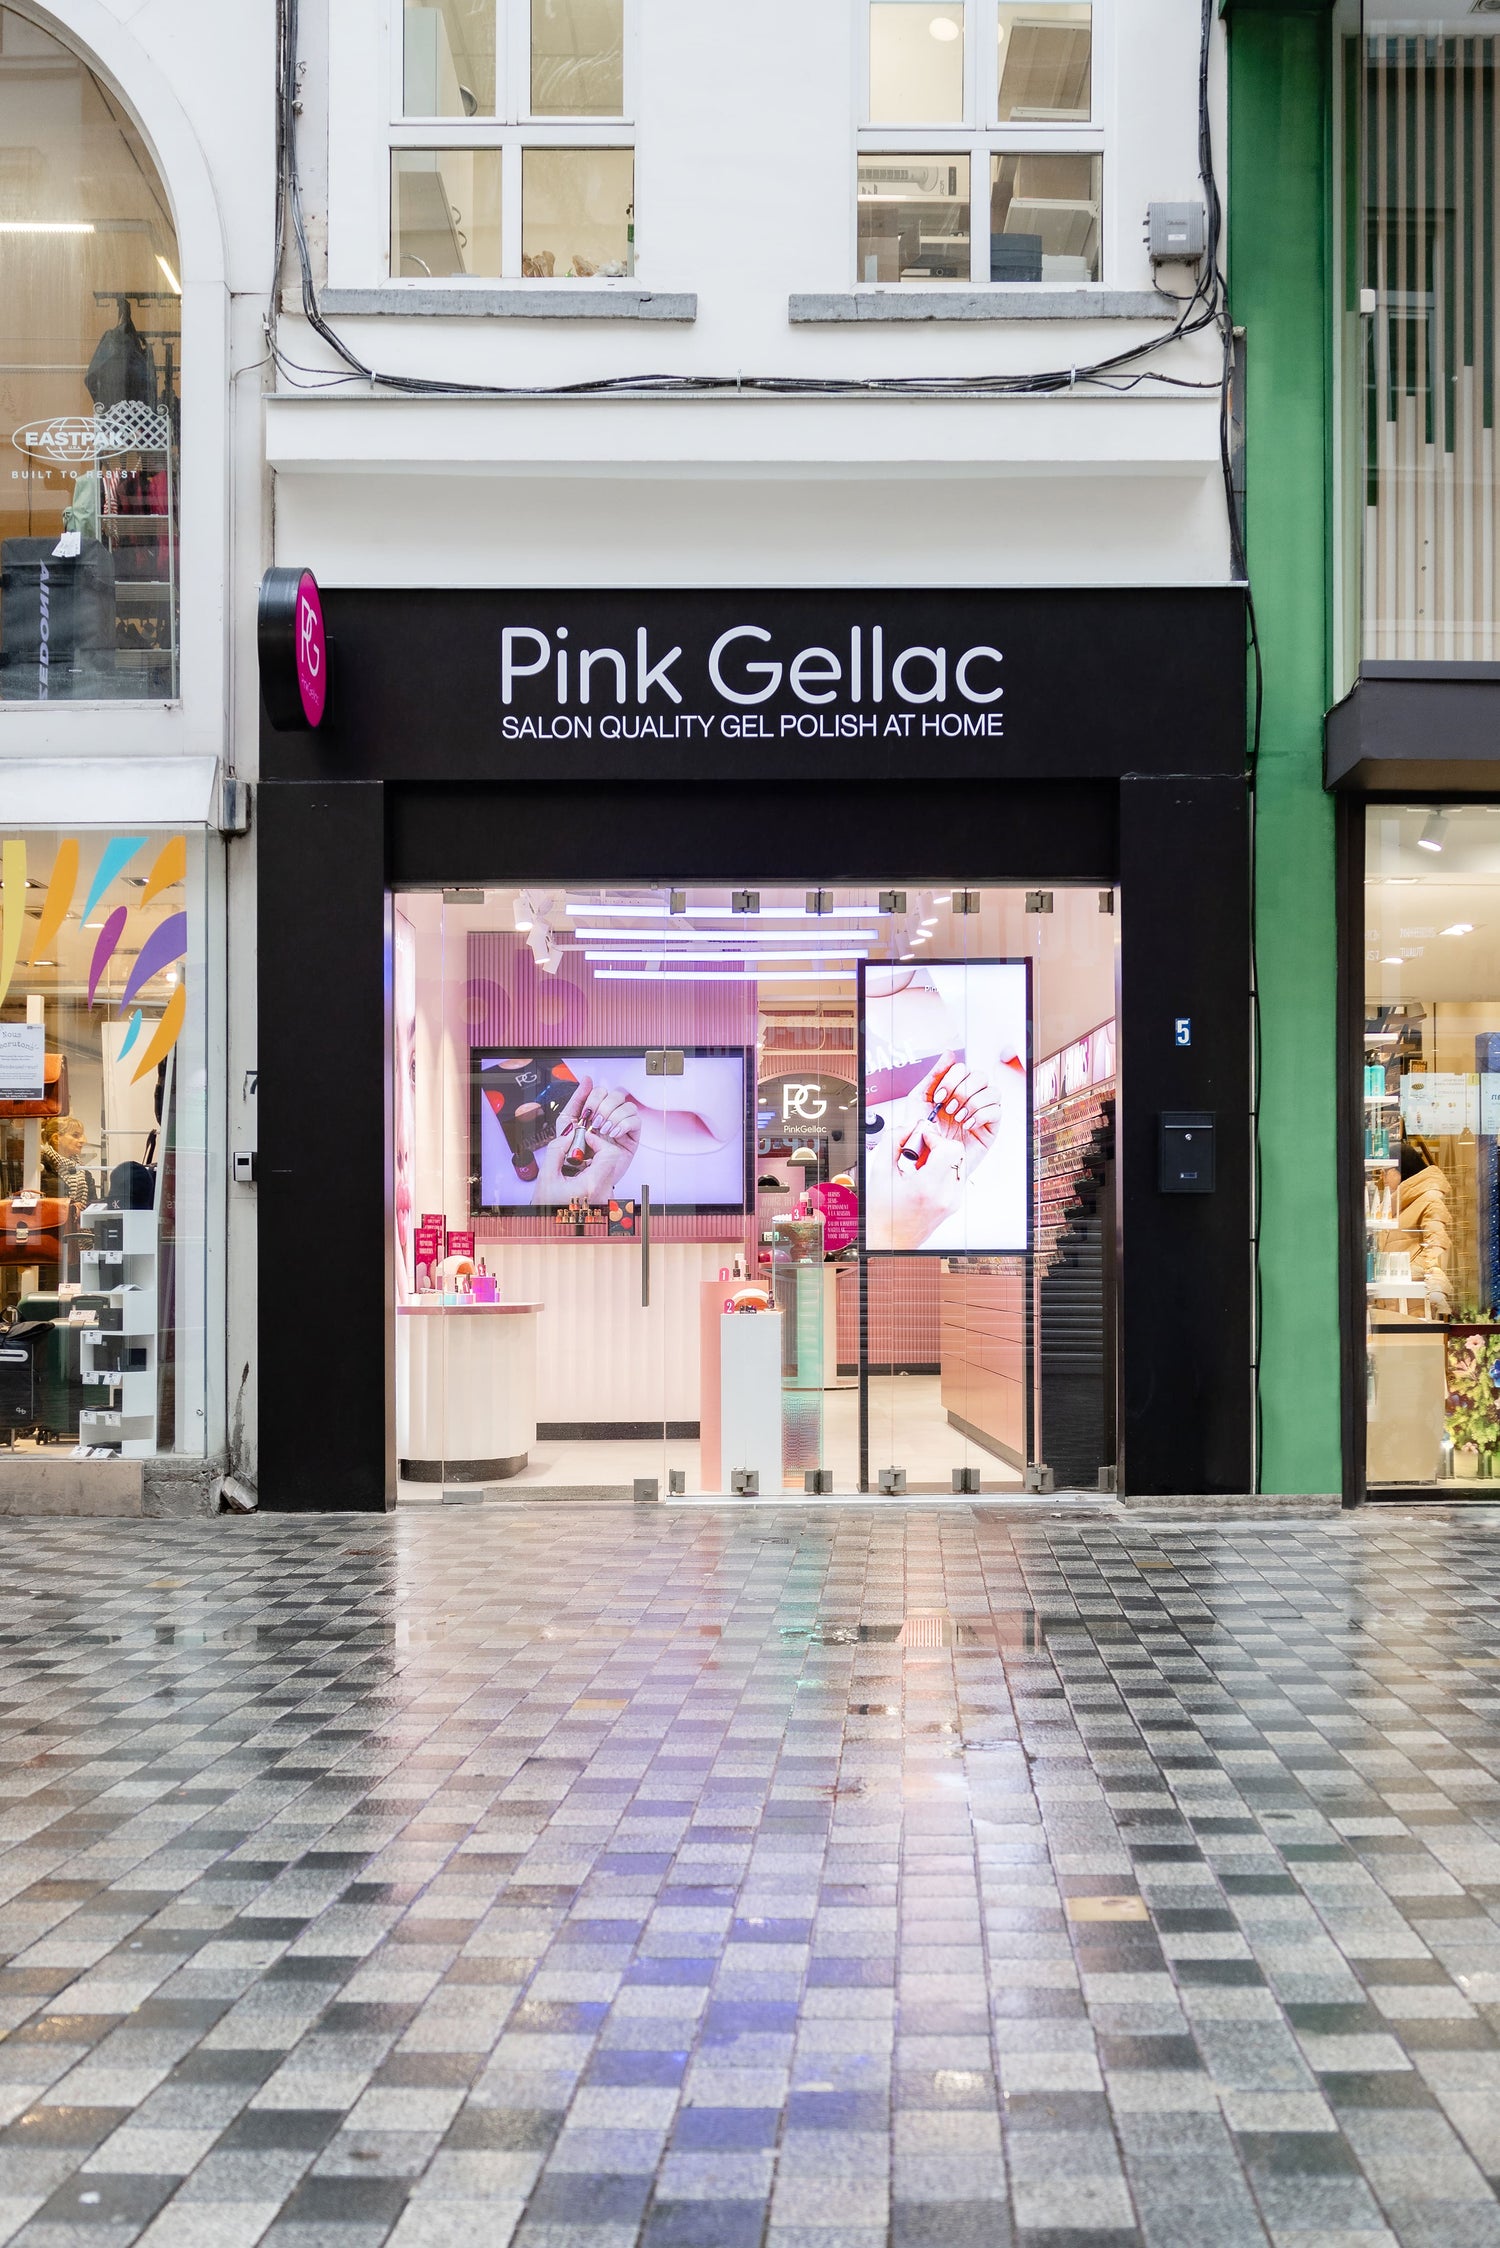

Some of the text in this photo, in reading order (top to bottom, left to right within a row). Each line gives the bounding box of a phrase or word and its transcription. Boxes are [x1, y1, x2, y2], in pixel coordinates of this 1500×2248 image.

[25, 432, 124, 446] EASTPAK
[12, 470, 138, 479] BUILT TO RESIST
[502, 625, 1004, 704] Pink Gellac
[502, 714, 1004, 739] SALON QUALITY GEL POLISH AT HOME
[1177, 1019, 1190, 1044] 5
[794, 1208, 800, 1220] 3
[722, 1270, 727, 1280] 1
[726, 1302, 733, 1313] 2
